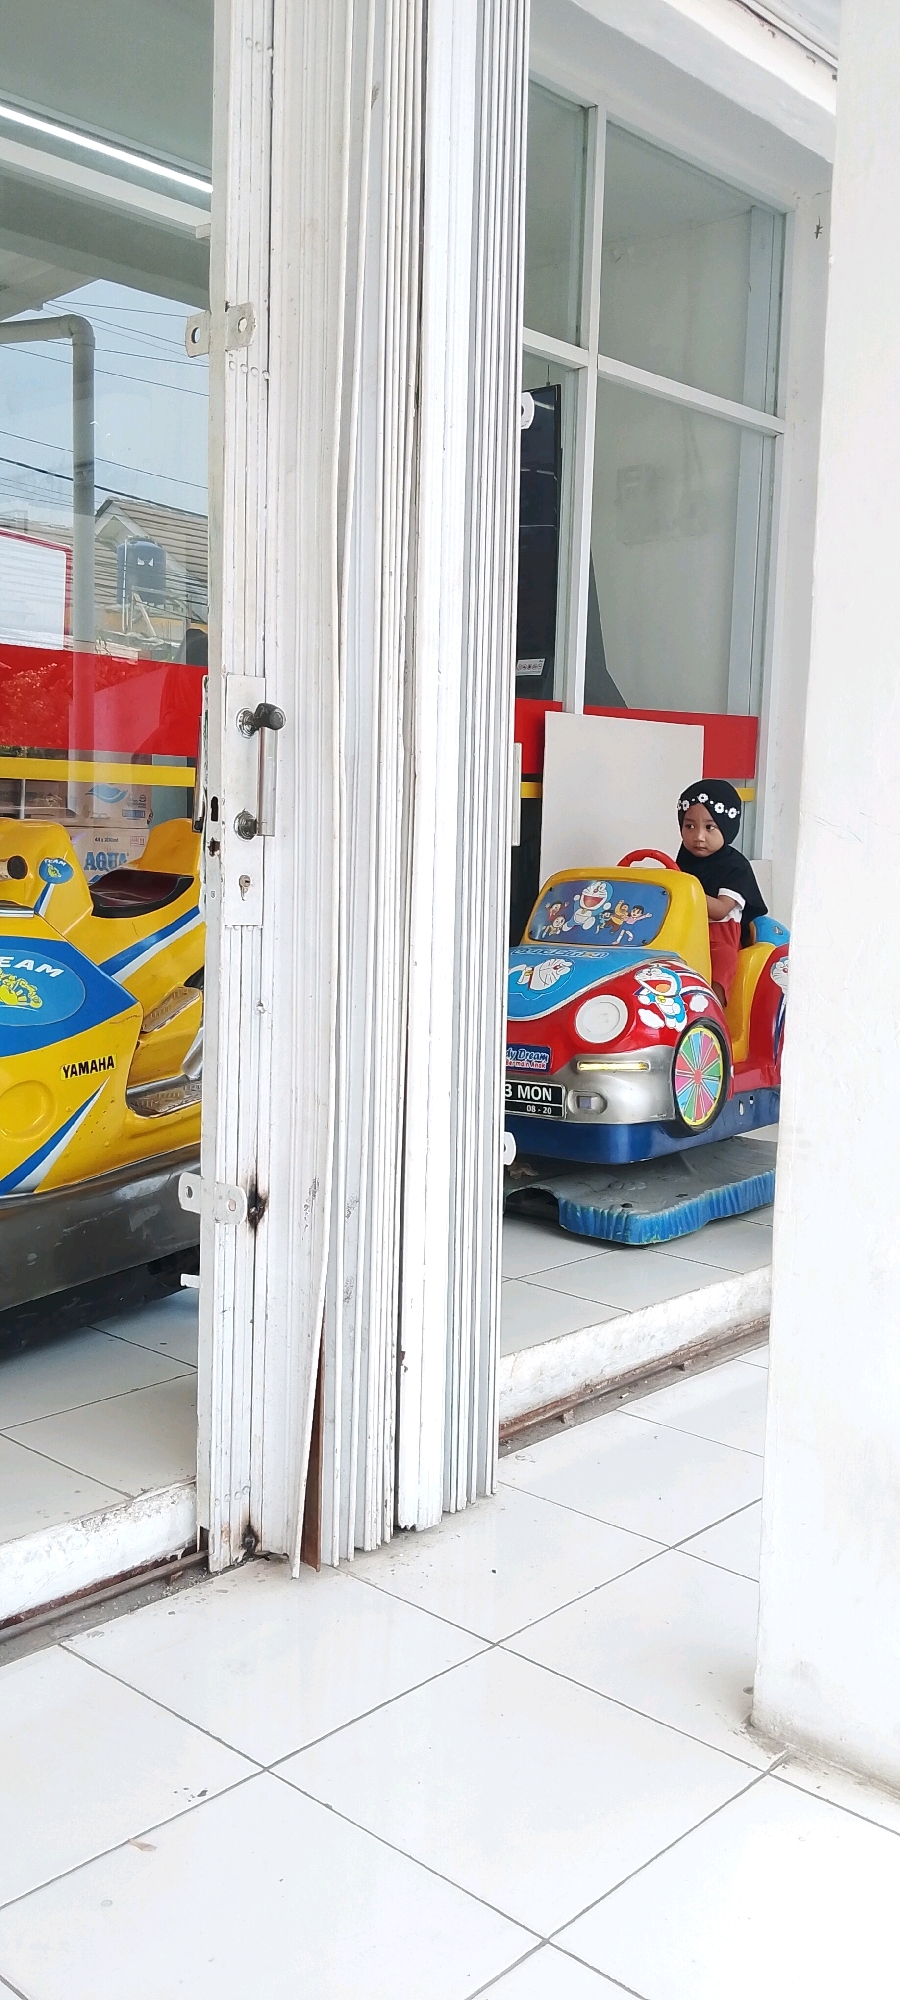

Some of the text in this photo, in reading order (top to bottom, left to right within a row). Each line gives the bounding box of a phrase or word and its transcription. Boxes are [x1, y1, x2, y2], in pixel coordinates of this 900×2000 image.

[84, 851, 128, 871] AQUA
[517, 1048, 549, 1064] Dream
[63, 1055, 115, 1079] YAMAHA
[517, 1084, 552, 1102] MON
[542, 1106, 552, 1115] 20
